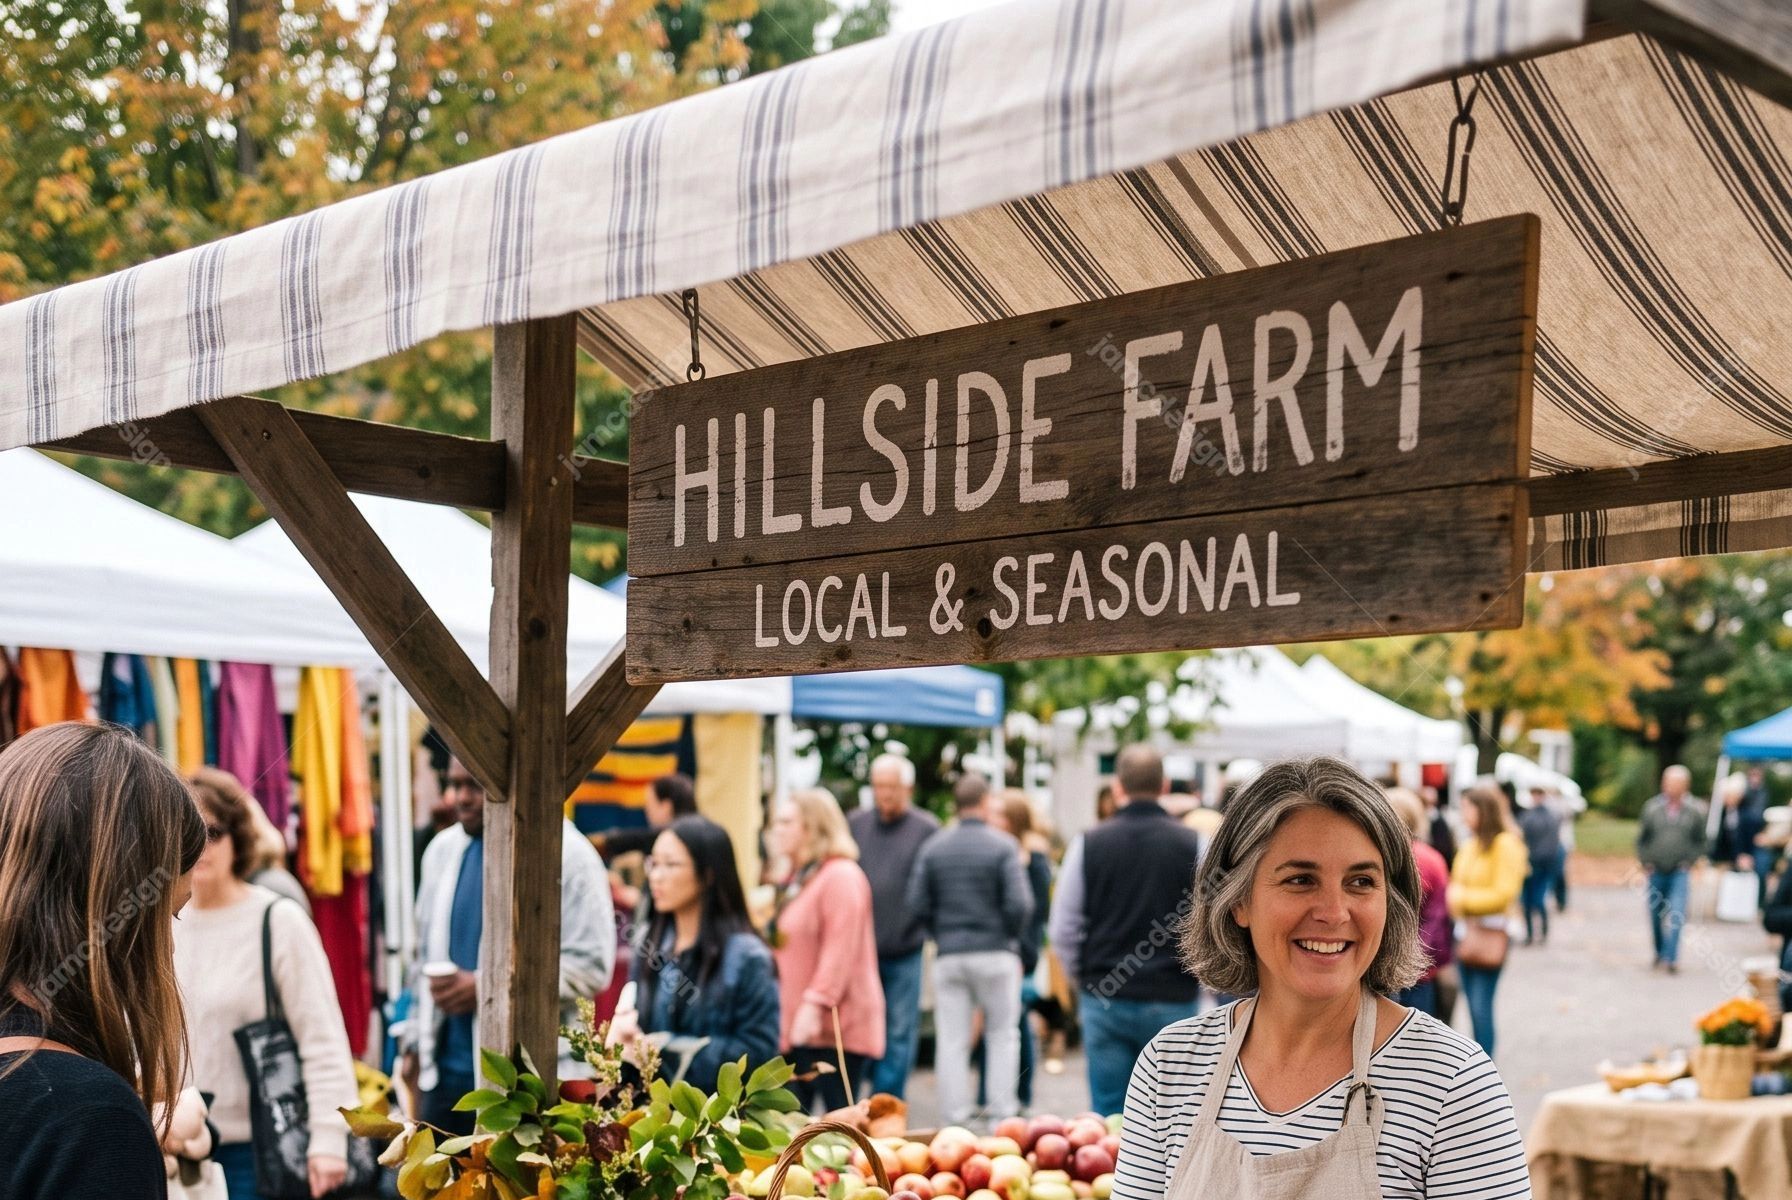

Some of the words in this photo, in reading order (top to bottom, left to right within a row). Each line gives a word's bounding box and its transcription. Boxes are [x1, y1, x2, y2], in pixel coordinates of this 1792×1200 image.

[673, 353, 1072, 547] HILLSIDE
[1121, 286, 1424, 490] FARM
[755, 571, 907, 648] LOCAL
[929, 562, 964, 635] &
[989, 531, 1300, 630] SEASONAL
